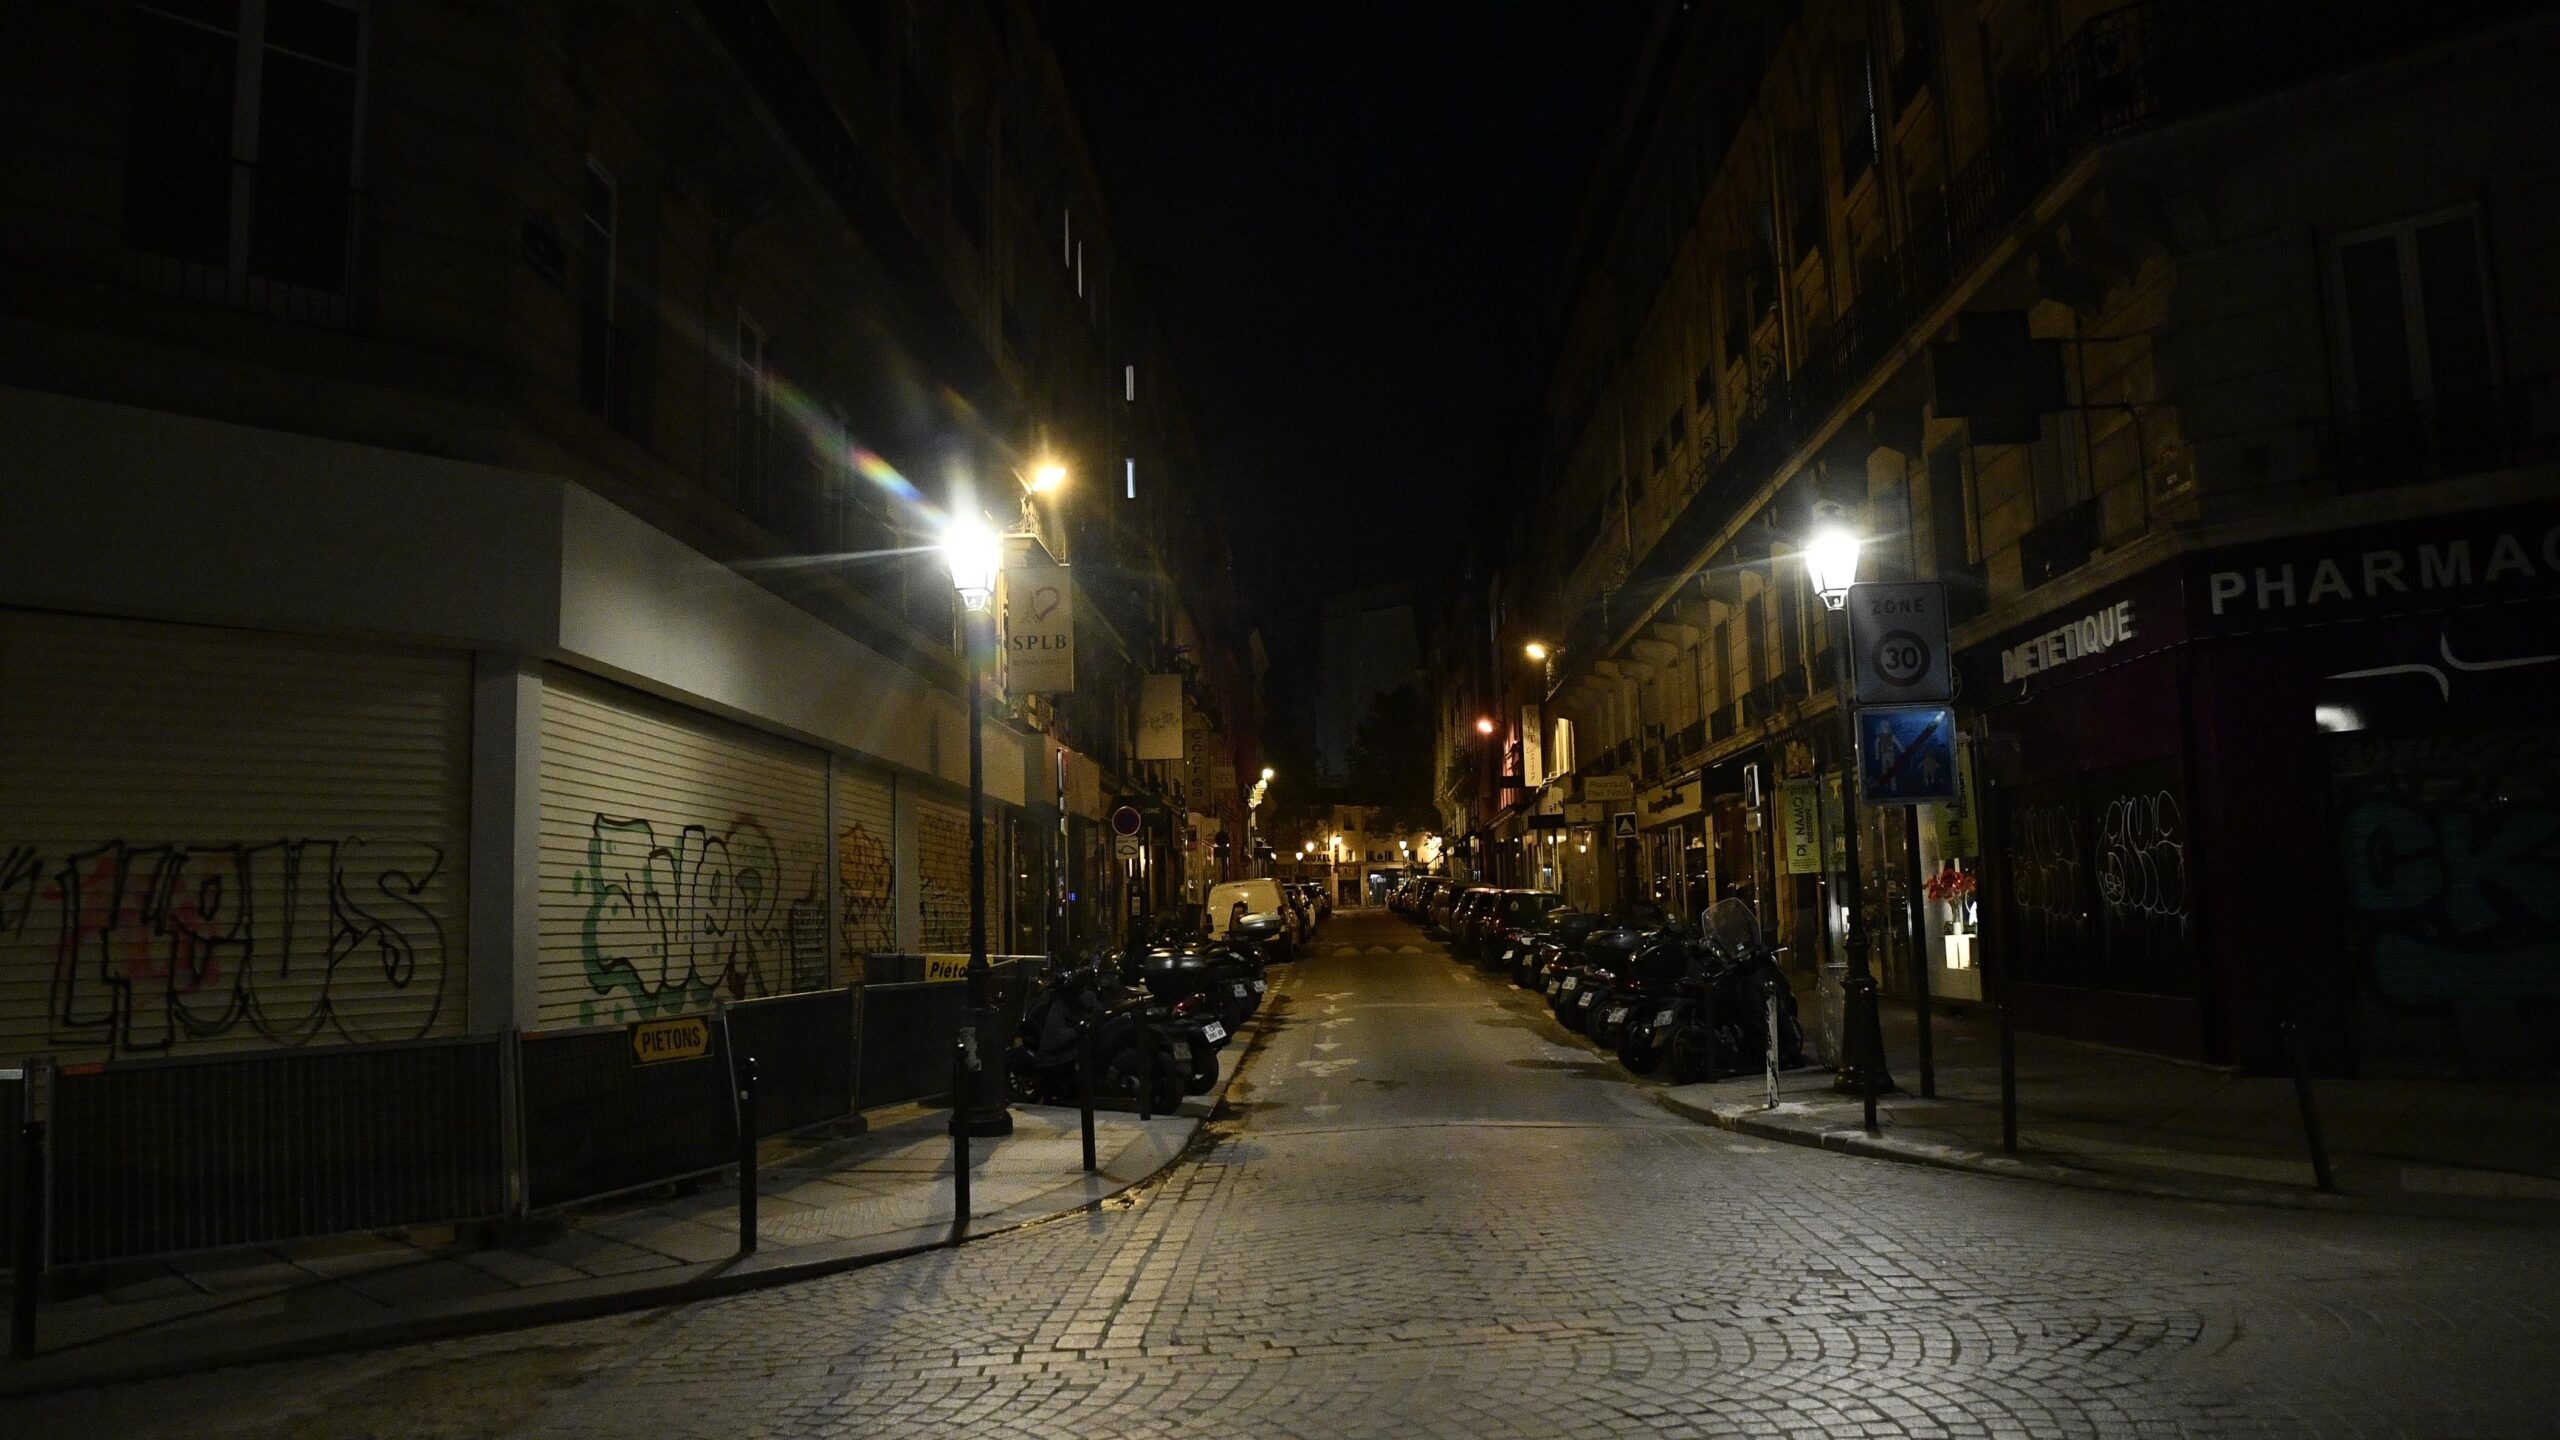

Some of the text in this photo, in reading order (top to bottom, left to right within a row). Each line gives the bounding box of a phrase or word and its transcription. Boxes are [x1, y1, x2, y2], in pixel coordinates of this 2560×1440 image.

[1872, 598, 1925, 614] ZONE
[1013, 634, 1067, 651] SPLB
[1885, 647, 1918, 669] 30
[1302, 853, 1331, 863] OUXEL
[930, 961, 969, 978] Piéto
[641, 1026, 701, 1053] PIETONS
